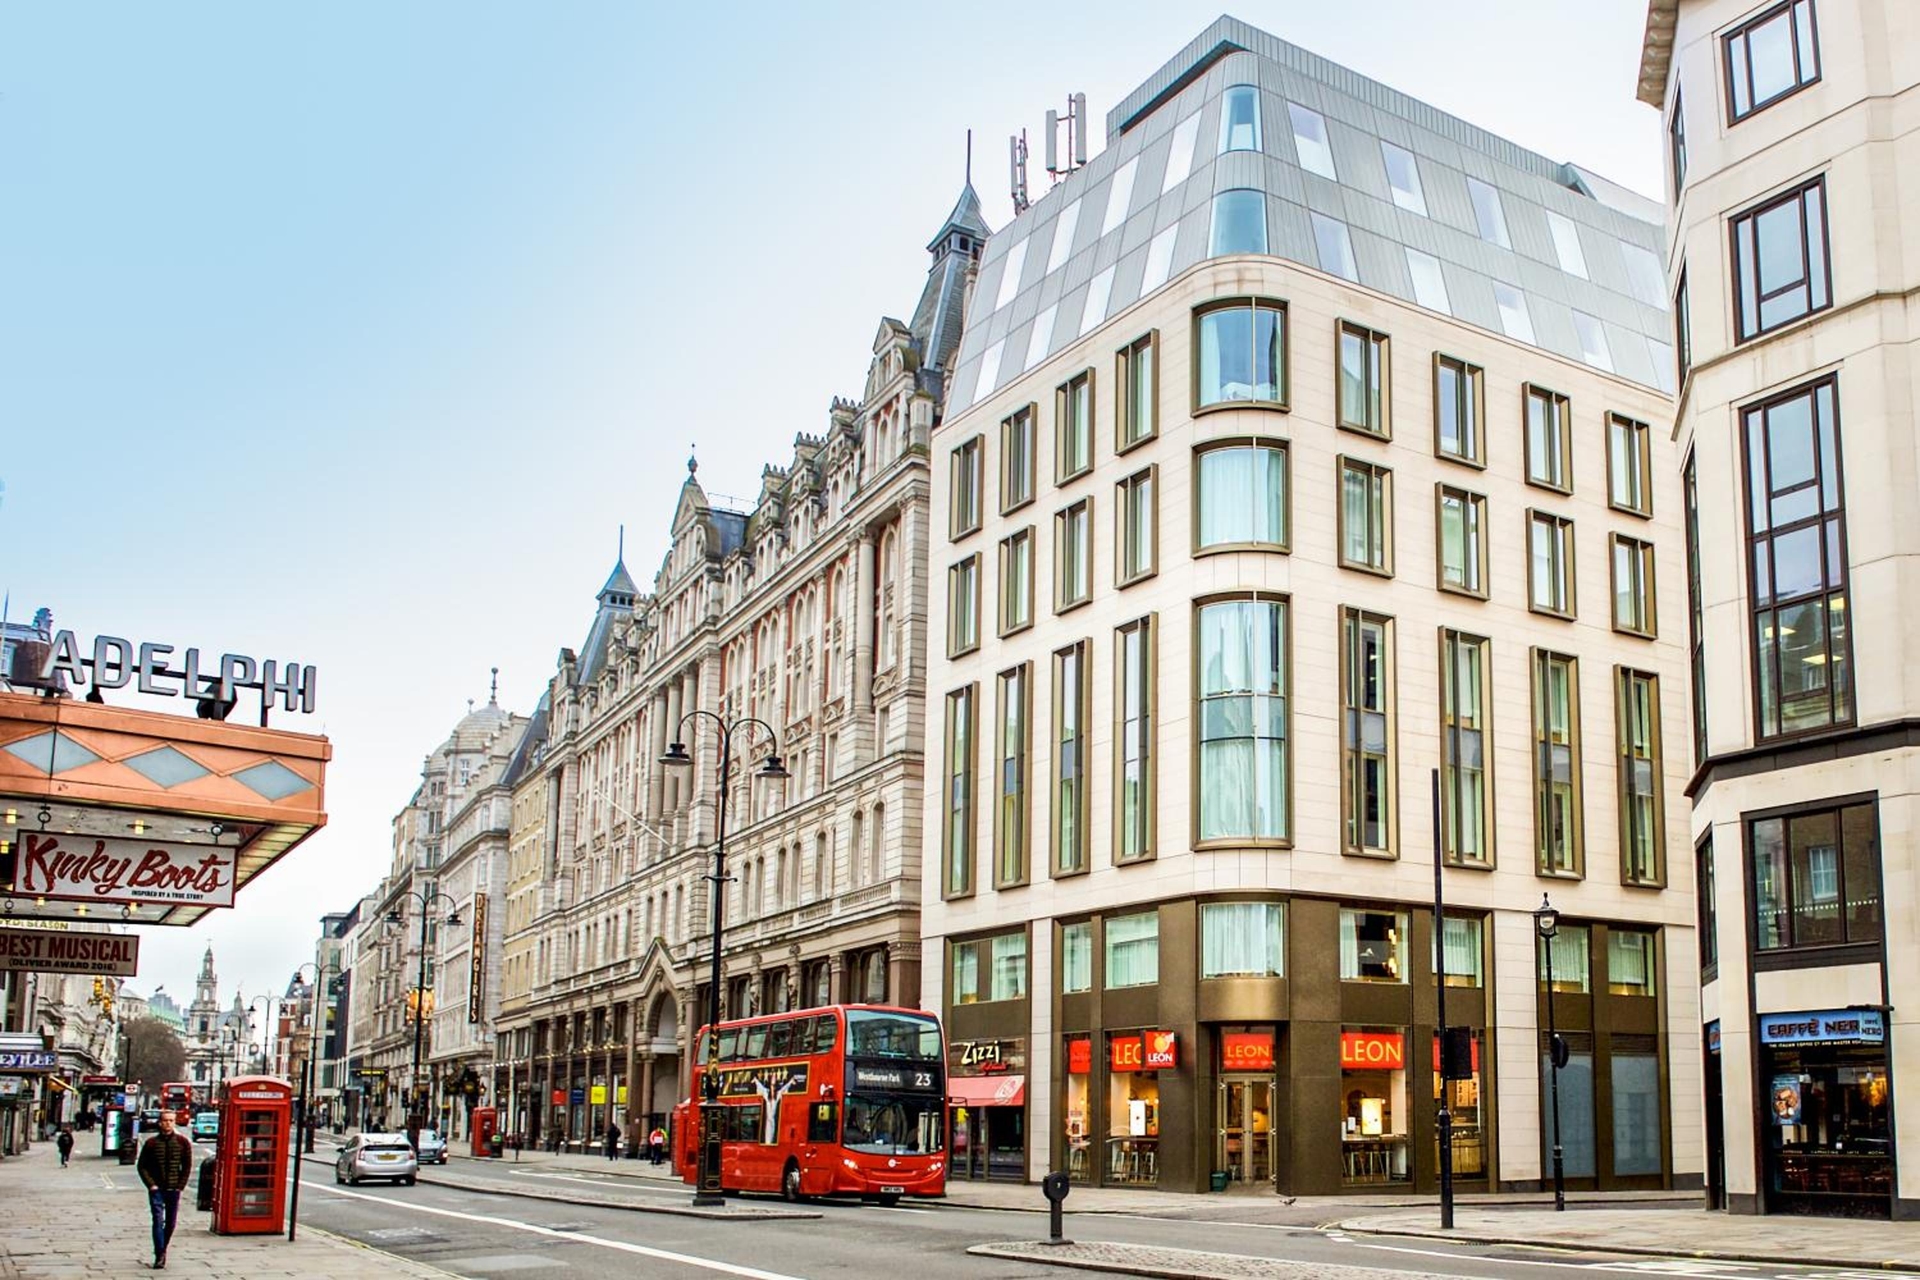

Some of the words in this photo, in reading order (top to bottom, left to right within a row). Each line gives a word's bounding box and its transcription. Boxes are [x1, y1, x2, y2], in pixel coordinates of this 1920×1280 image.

[38, 629, 317, 714] ADELPHI
[23, 834, 132, 895] Kinky
[127, 849, 232, 893] Boots
[0, 934, 44, 957] BEST
[48, 936, 132, 962] MUSICAL
[53, 960, 89, 969] AWARD
[1824, 1019, 1860, 1036] NER
[961, 1040, 1000, 1065] Zizzi
[1147, 1052, 1173, 1063] LEON
[1226, 1044, 1271, 1059] LEON
[1341, 1039, 1402, 1063] LEON
[915, 1073, 931, 1086] 23
